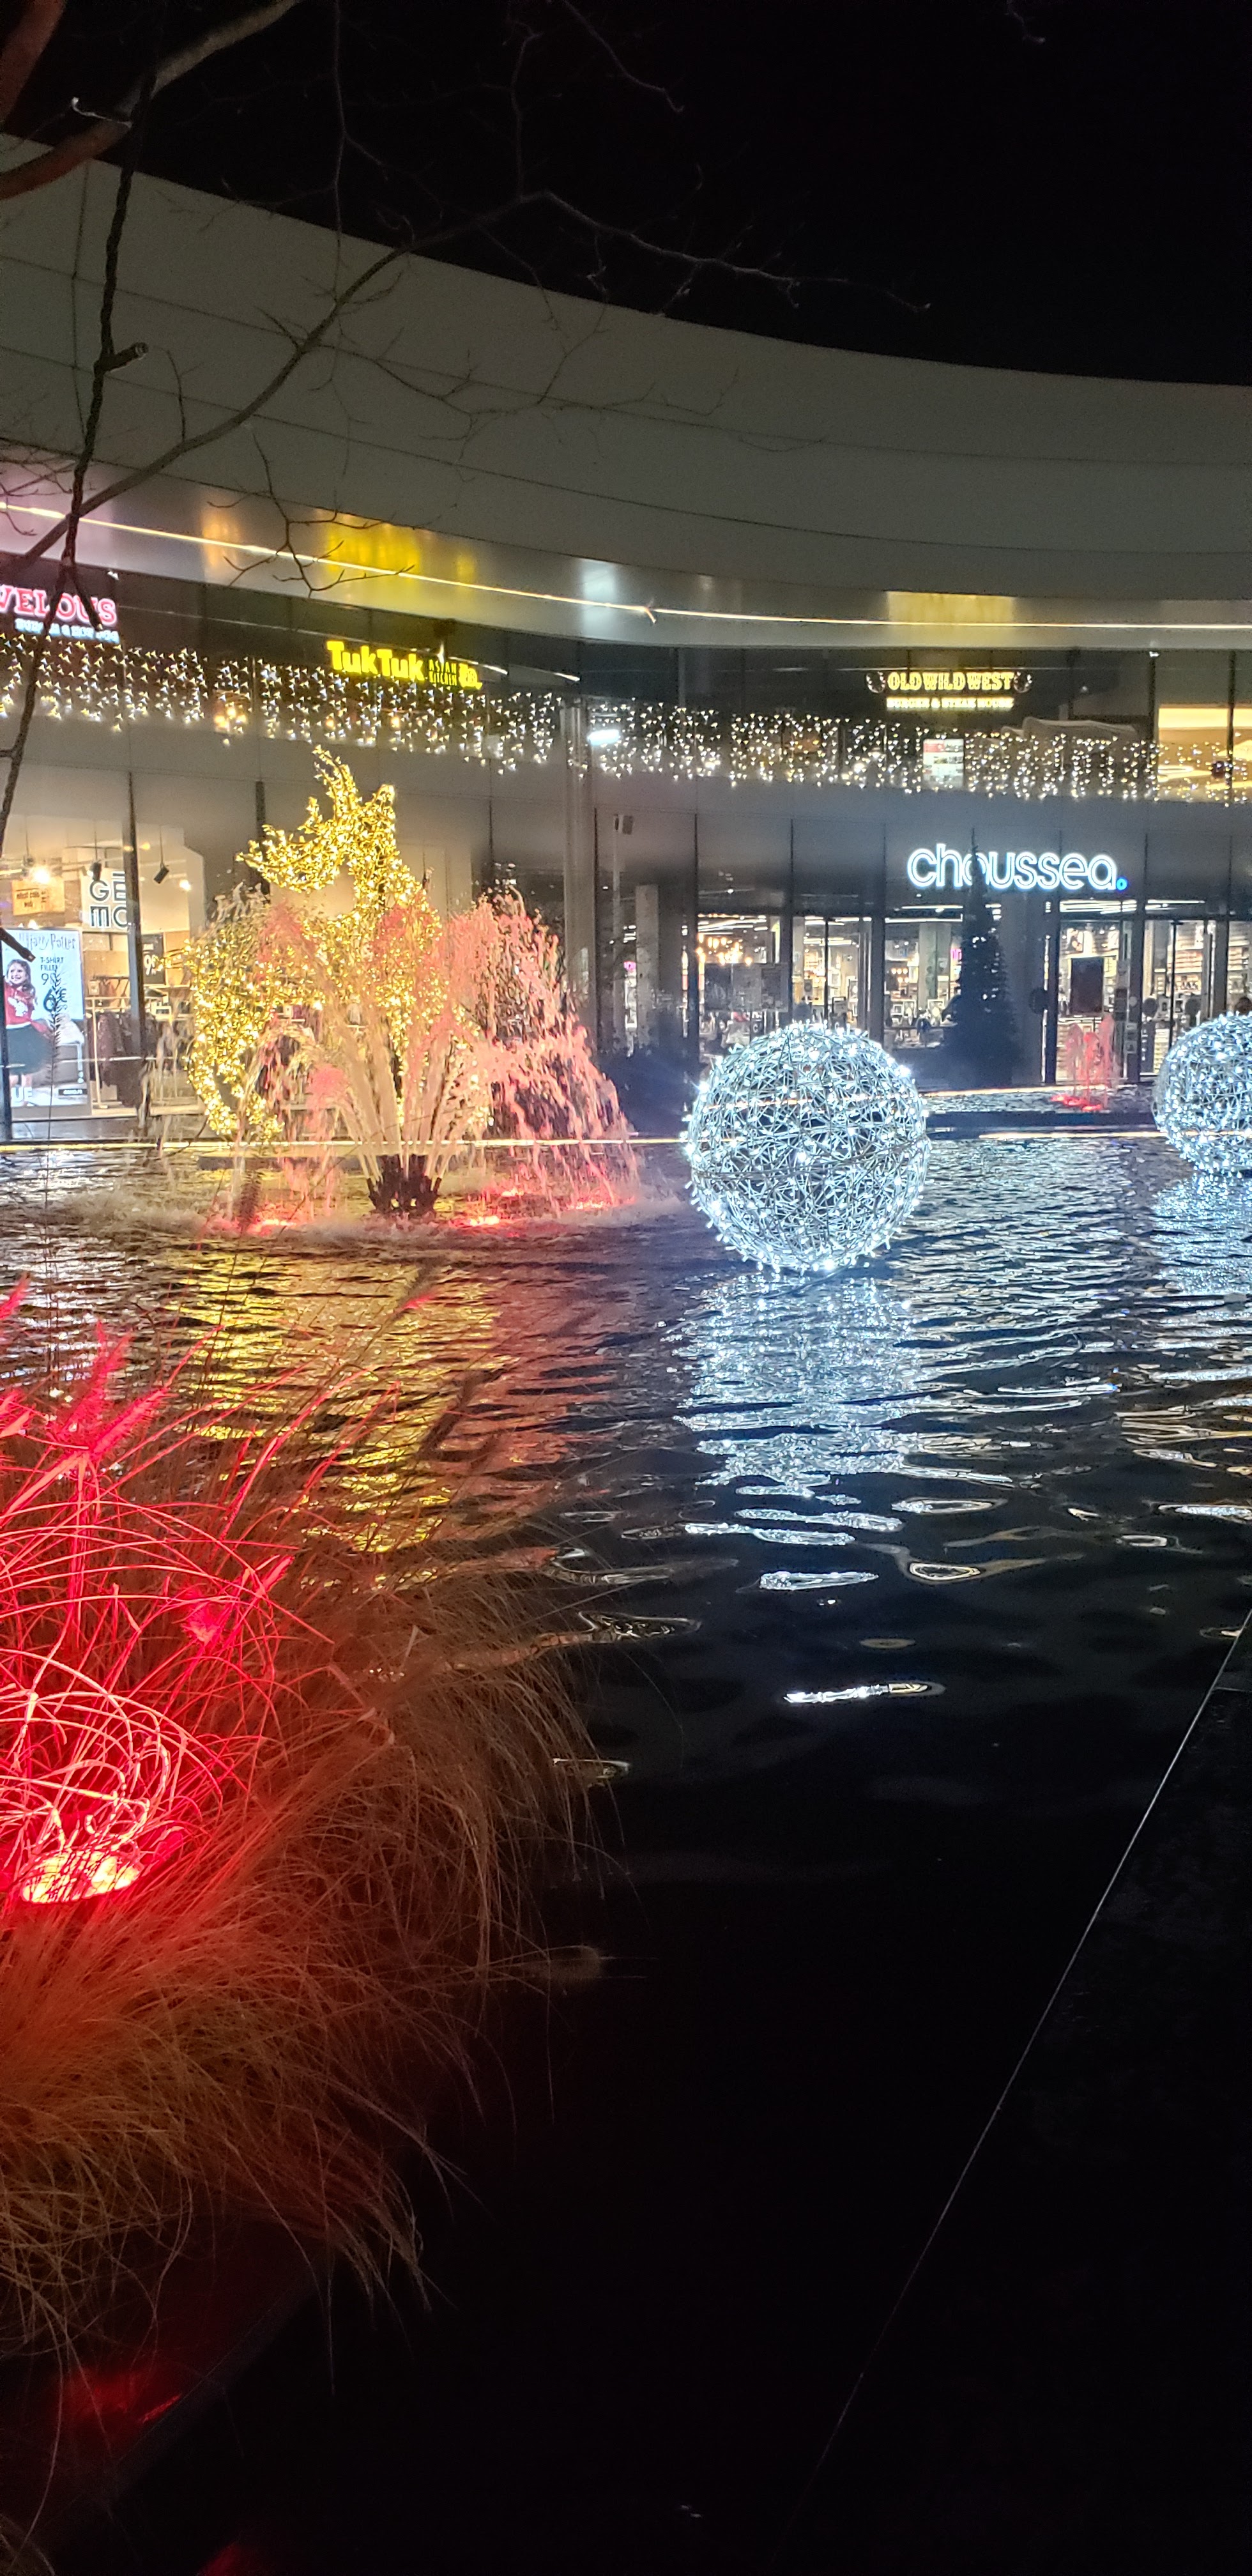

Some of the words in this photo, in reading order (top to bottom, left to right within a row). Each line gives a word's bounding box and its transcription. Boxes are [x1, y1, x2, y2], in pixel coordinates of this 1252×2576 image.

[429, 659, 457, 674] ASIAN
[429, 671, 457, 686] KITCHEN
[887, 671, 922, 690] OLD
[922, 671, 966, 690] WILD
[966, 671, 1014, 690] WEST
